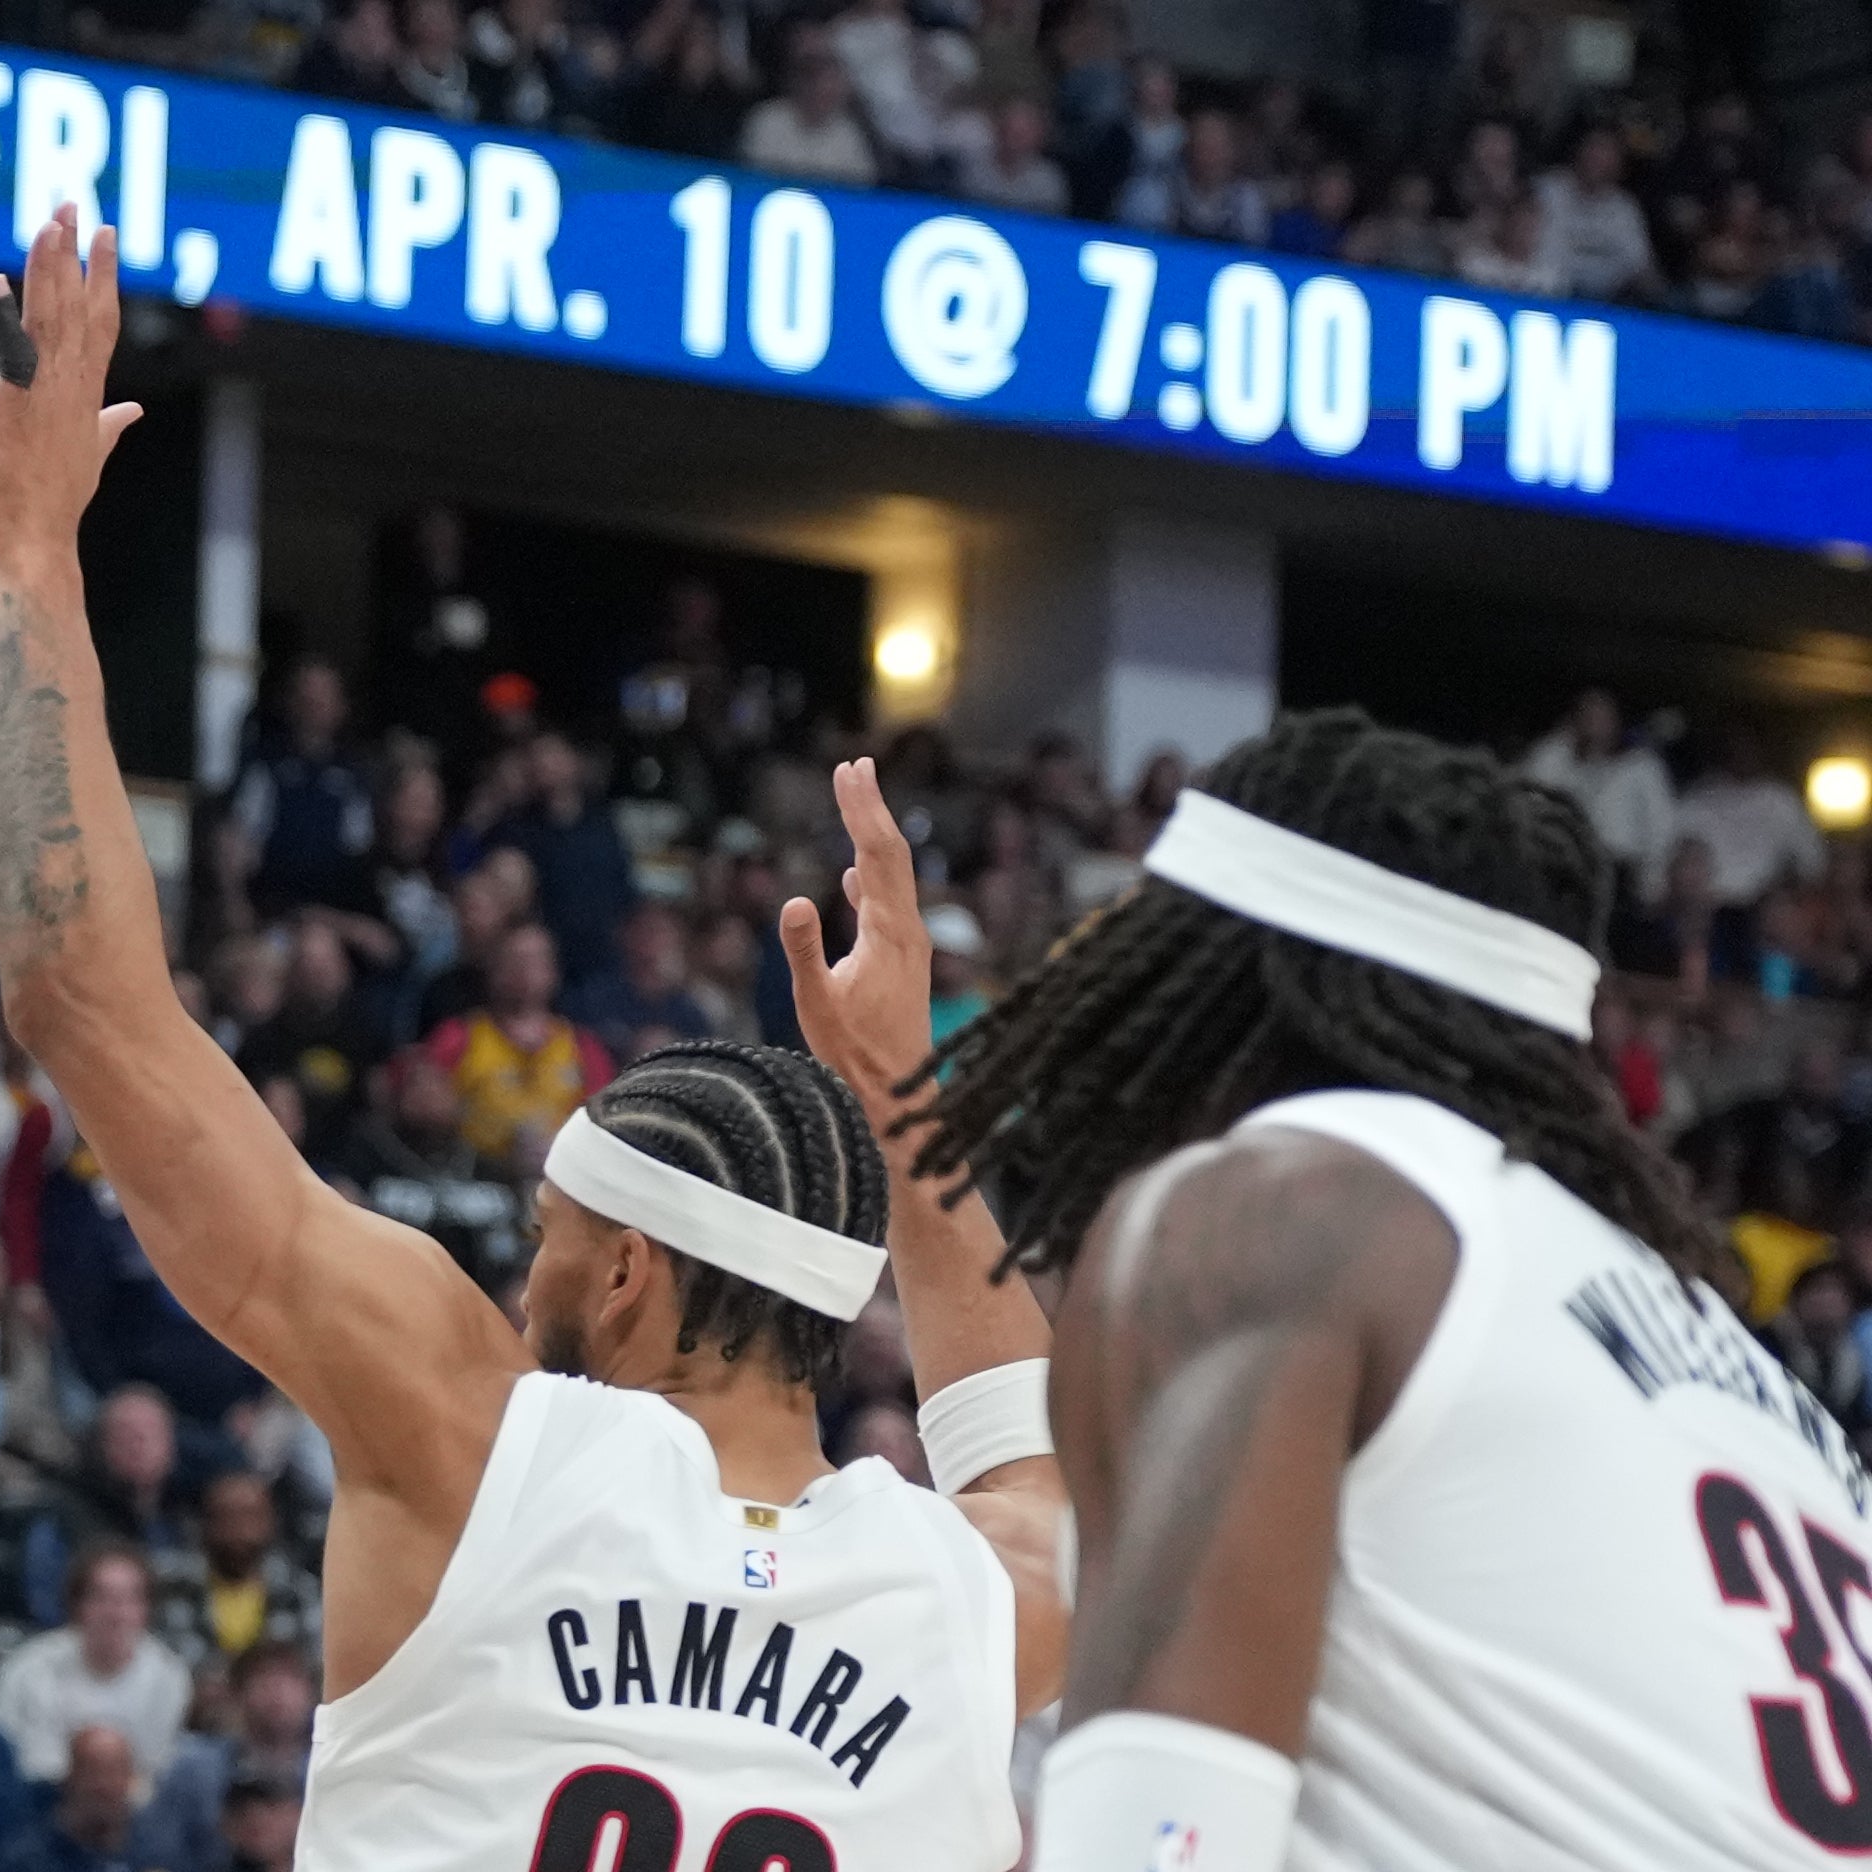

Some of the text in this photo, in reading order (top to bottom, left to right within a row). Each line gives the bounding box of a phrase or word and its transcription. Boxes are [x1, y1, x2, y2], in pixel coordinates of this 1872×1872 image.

[269, 114, 608, 341] APR.
[669, 175, 835, 374] 10
[881, 215, 1030, 400] @
[1079, 240, 1371, 457] 7:00
[1418, 295, 1616, 492] PM
[547, 1599, 912, 1789] CAMARA
